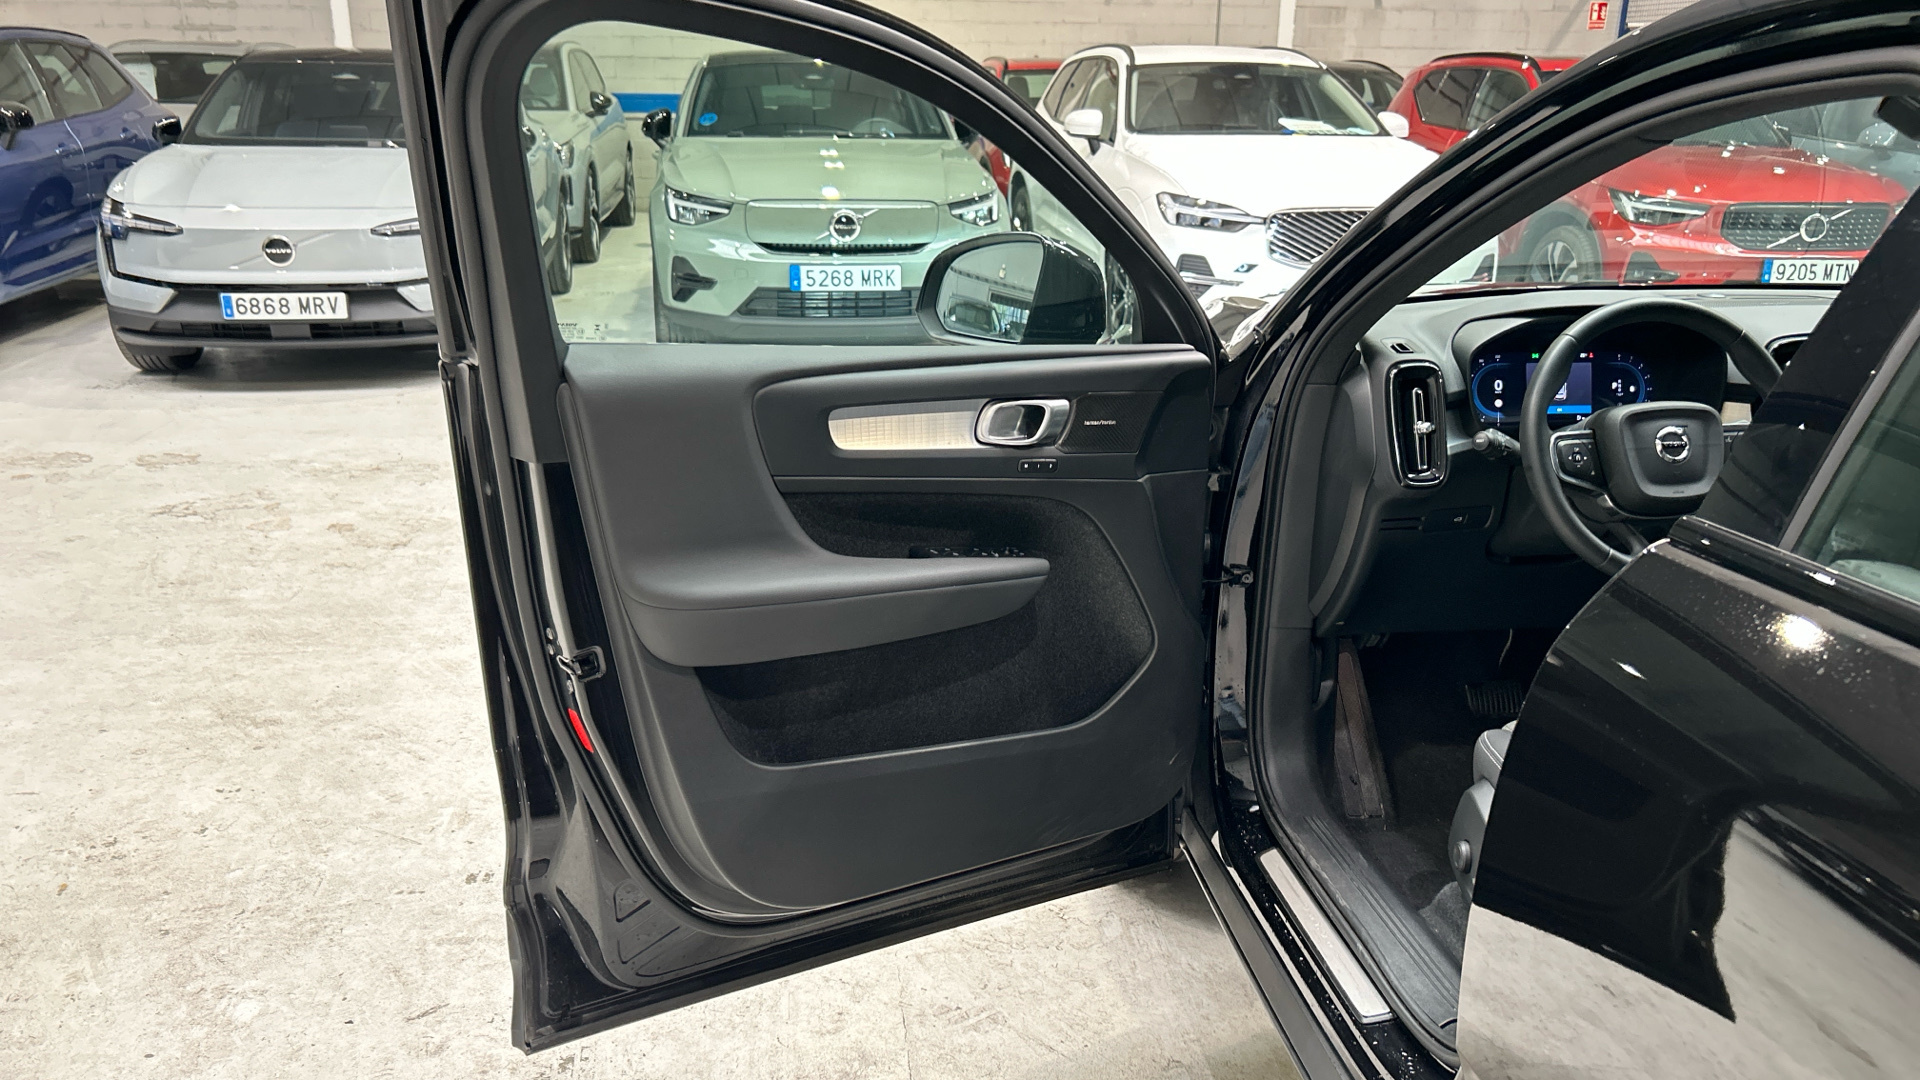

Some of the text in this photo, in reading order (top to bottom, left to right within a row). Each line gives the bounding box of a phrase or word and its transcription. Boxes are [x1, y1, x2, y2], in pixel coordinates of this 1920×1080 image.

[806, 269, 896, 287] 5268 MRK
[1775, 263, 1855, 281] 9205 MTN
[235, 296, 338, 315] 6868 MRV
[1494, 379, 1503, 391] 0
